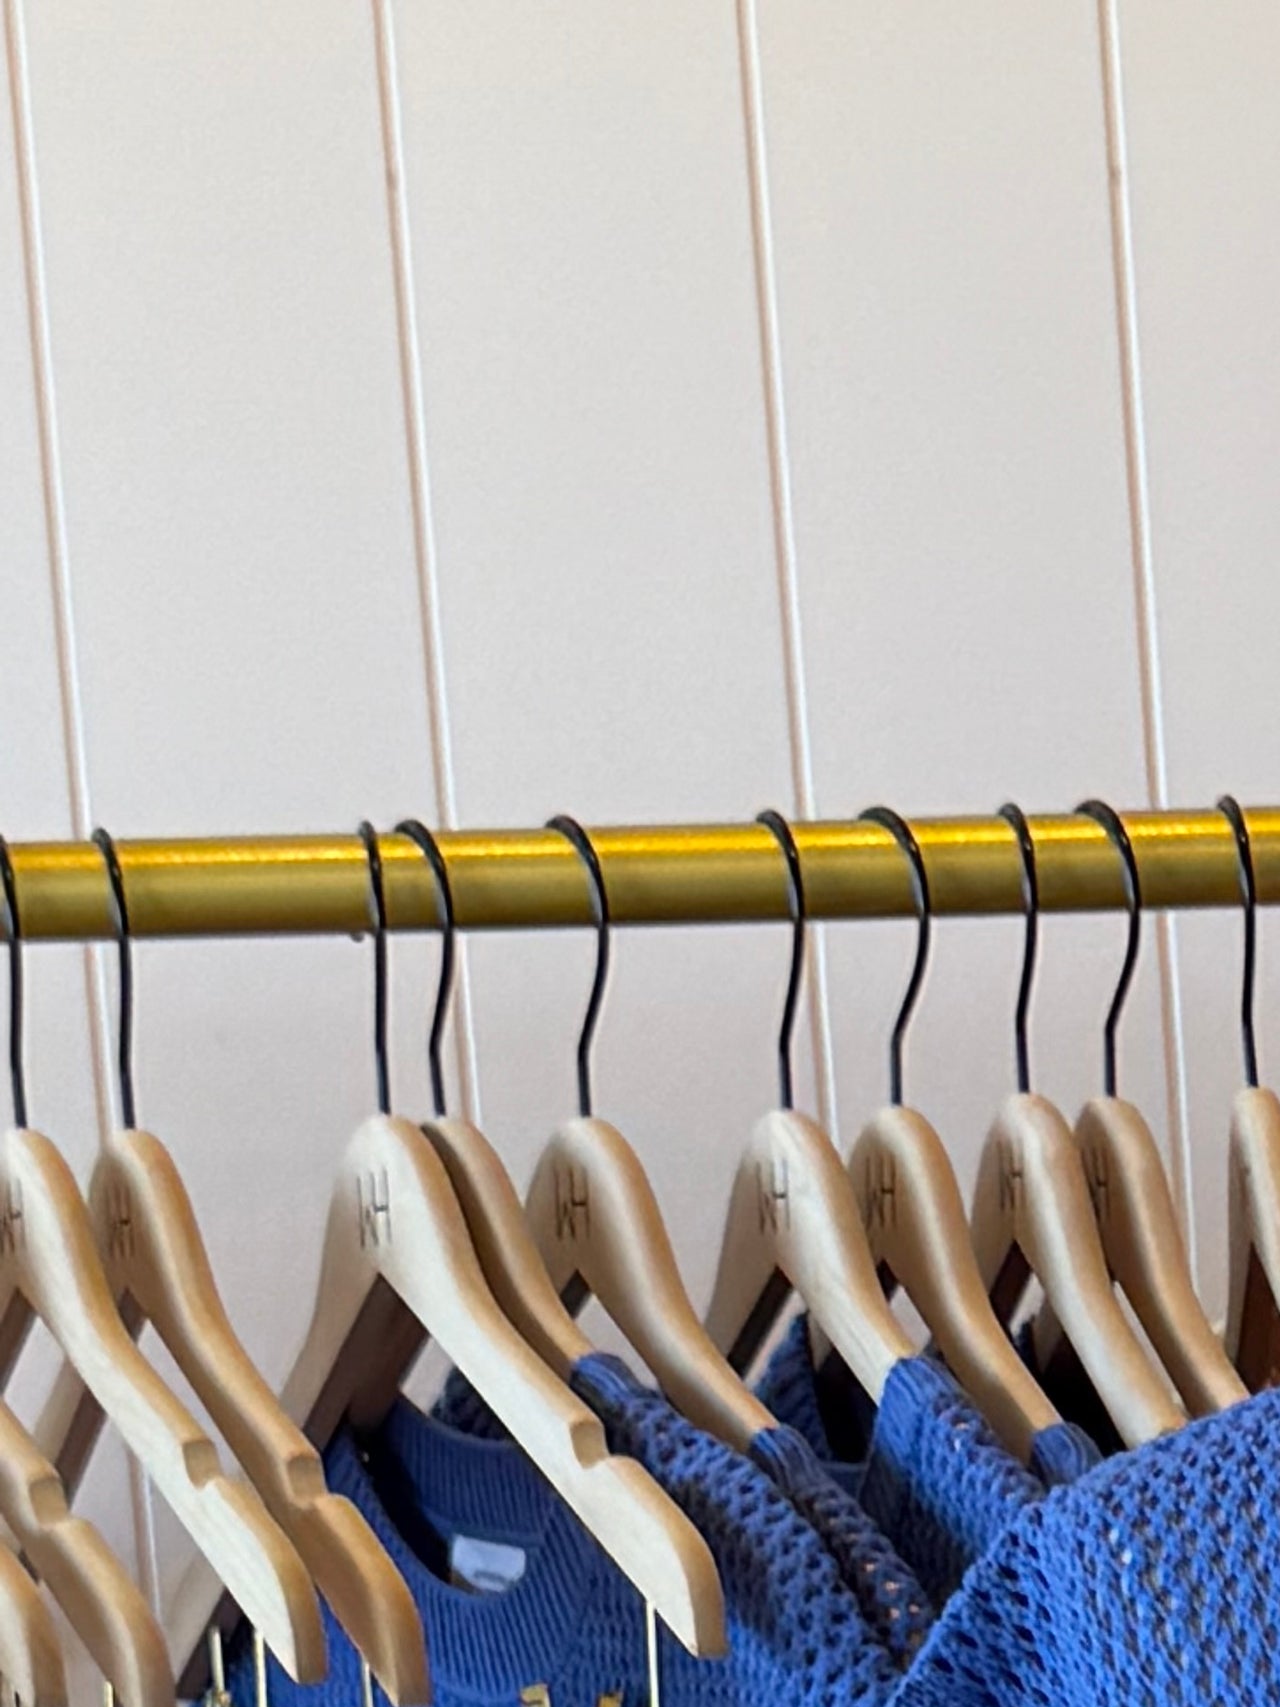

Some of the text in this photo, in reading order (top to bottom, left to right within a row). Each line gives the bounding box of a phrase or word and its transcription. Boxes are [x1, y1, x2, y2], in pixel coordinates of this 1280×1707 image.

[356, 1165, 392, 1249] WH
[555, 1165, 590, 1240] WH
[756, 1157, 791, 1235] WH
[864, 1153, 897, 1231] WH
